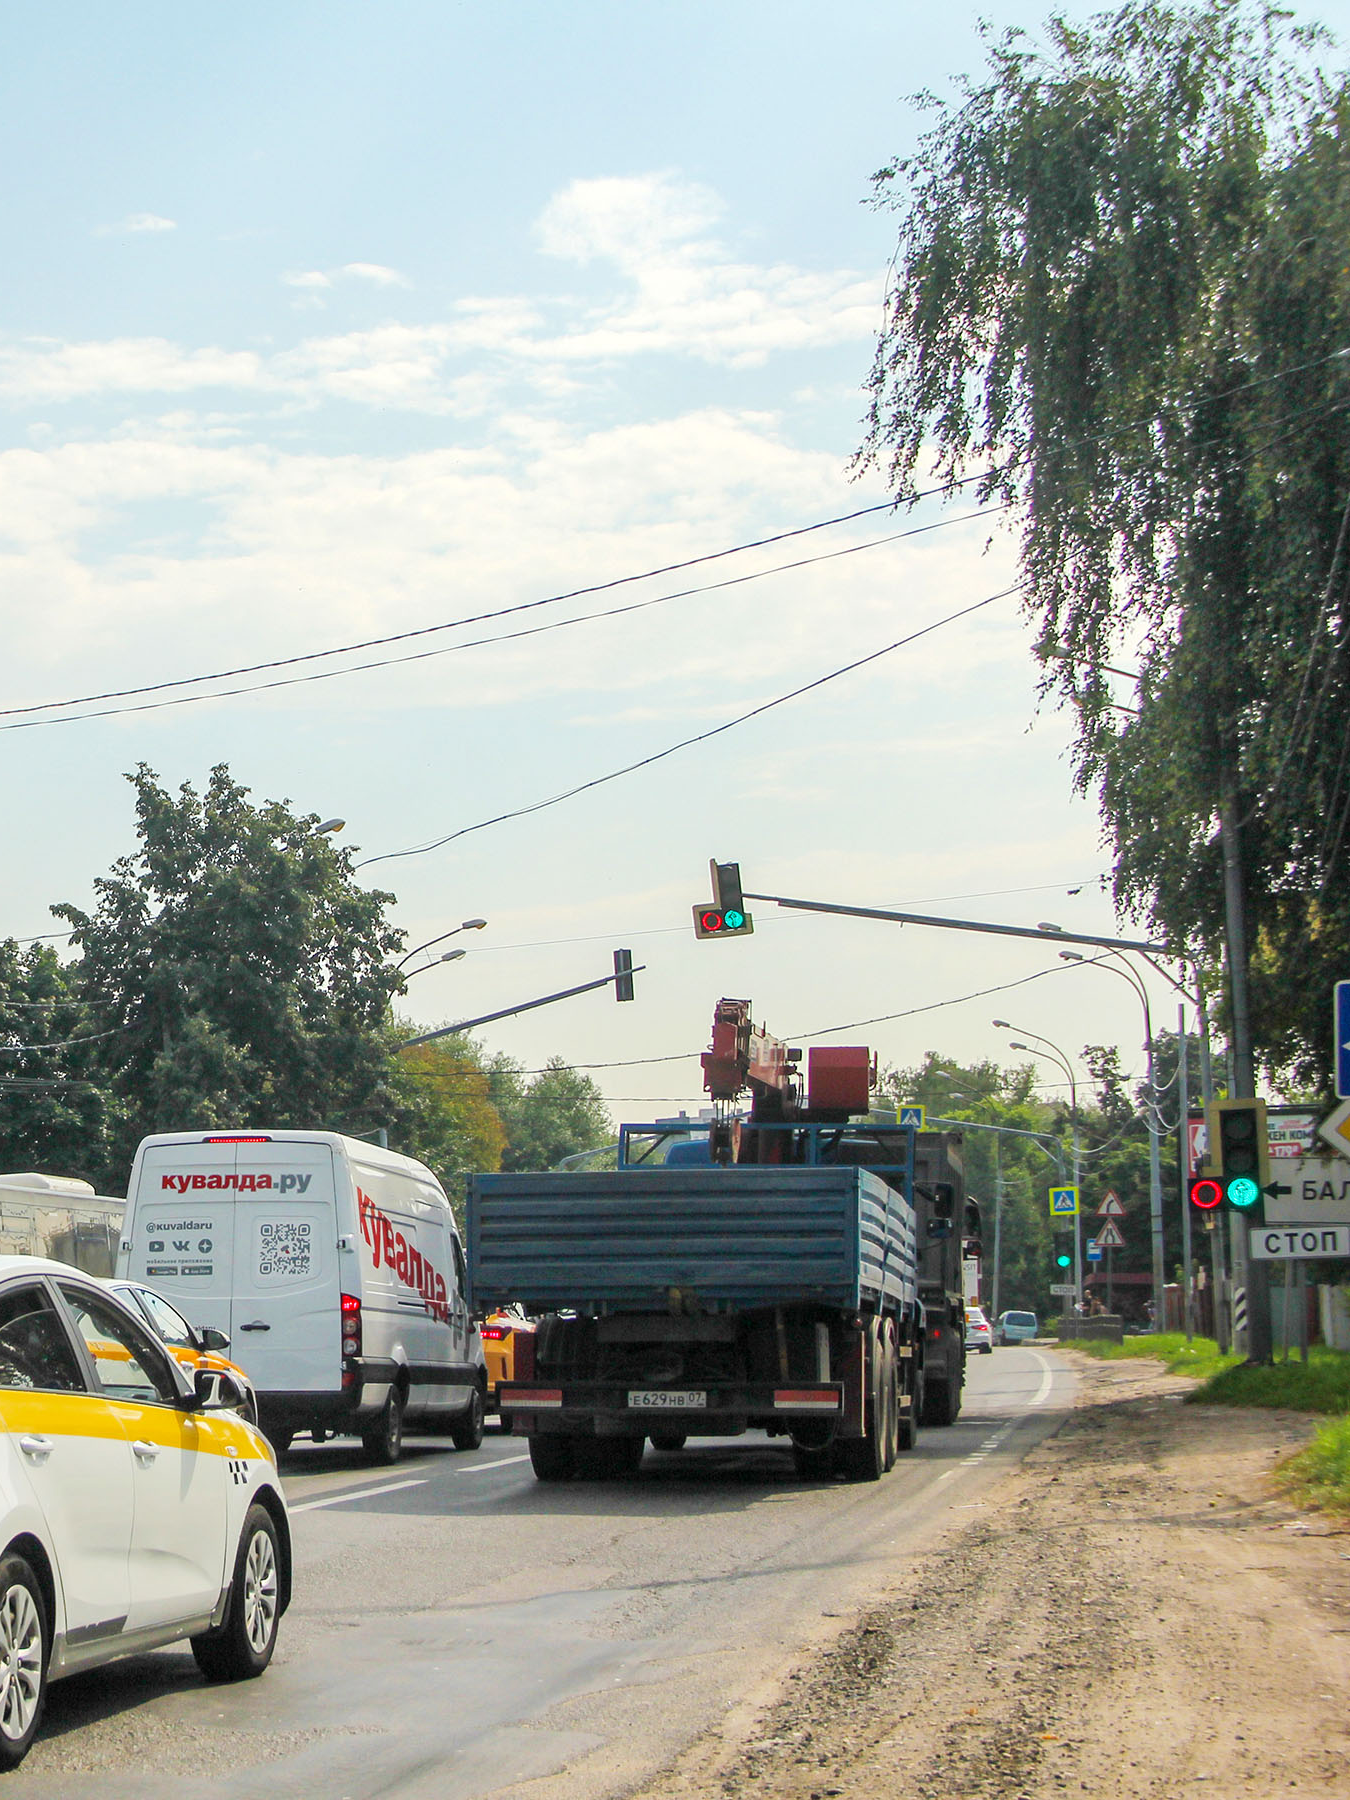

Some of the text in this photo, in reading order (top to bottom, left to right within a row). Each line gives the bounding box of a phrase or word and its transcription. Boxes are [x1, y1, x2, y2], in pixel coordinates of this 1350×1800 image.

[161, 1173, 313, 1194] кувалда.ру
[1264, 1231, 1338, 1254] СТОП
[688, 1392, 702, 1402] 07
